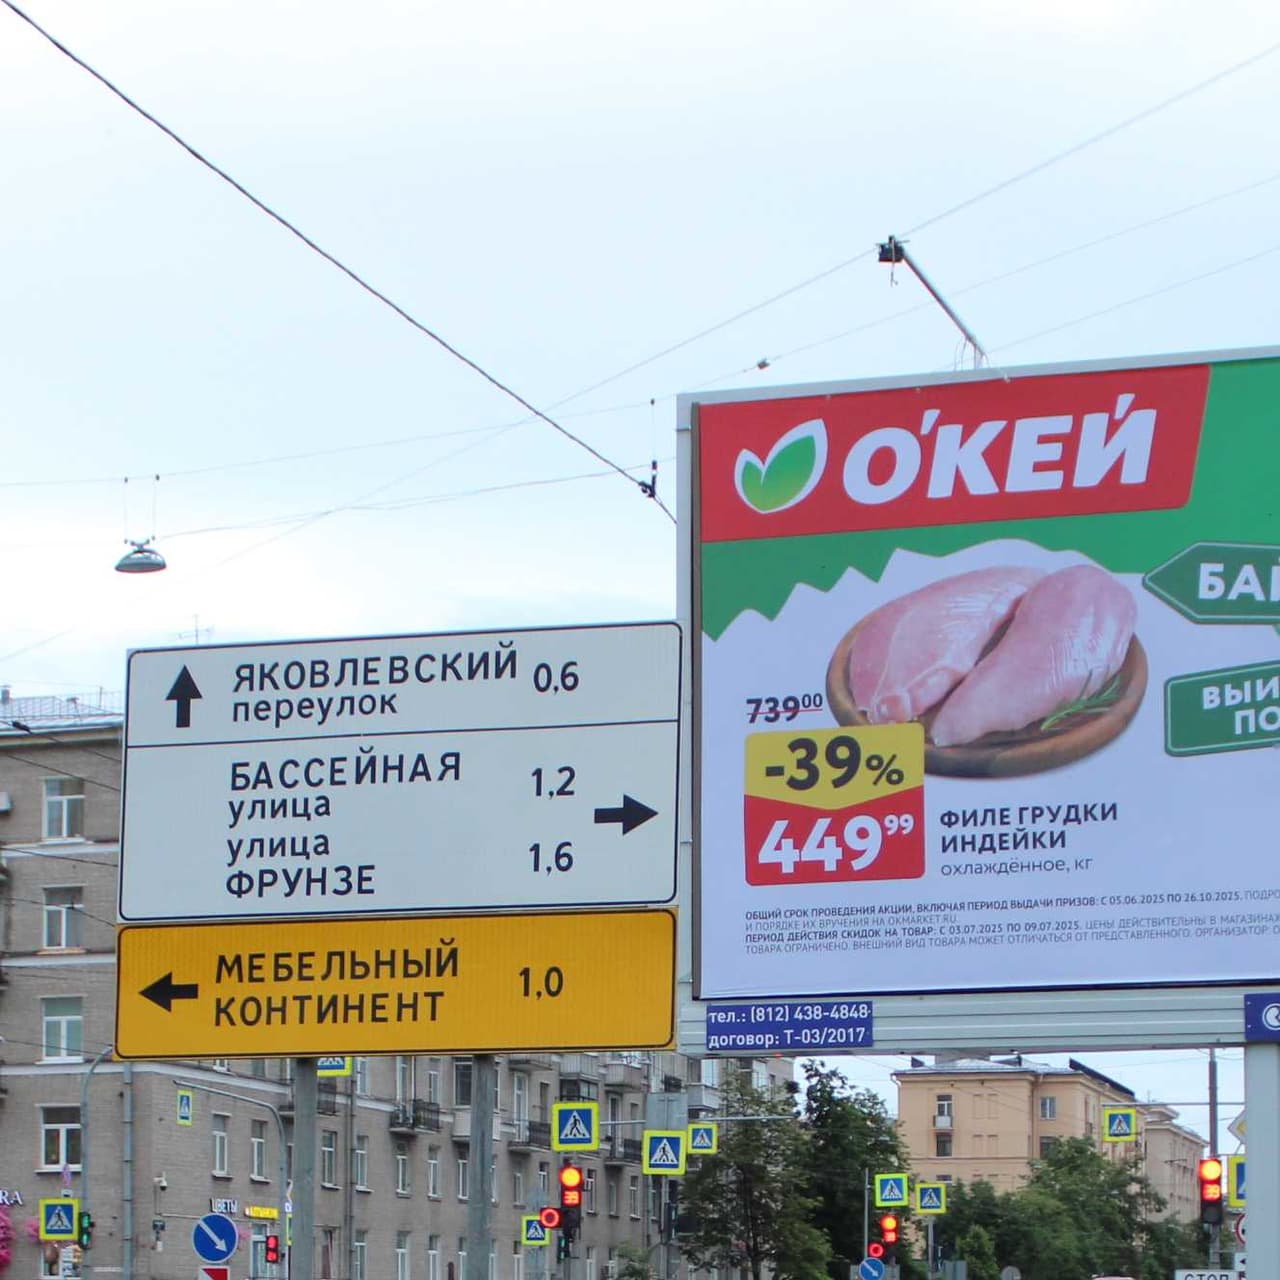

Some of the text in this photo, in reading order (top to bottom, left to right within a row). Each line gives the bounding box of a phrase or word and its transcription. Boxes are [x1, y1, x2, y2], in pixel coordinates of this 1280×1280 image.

[232, 641, 580, 695] ЯКОВЛЕВСКИЙ 0,6
[232, 692, 398, 728] переулок
[230, 745, 576, 799] БАССЕЙНАЯ 1,2
[765, 735, 904, 791] -39%
[227, 794, 331, 828] улица
[940, 802, 1119, 828] ФИЛЕ ГРУДКИ
[226, 834, 573, 876] улица 1,6
[941, 828, 1067, 854] ИНДЕЙКИ
[225, 865, 376, 899] ФРУНЗЕ
[940, 856, 1094, 878] охлаждённое, кг
[745, 907, 781, 920] ОБЩИЙ
[783, 908, 809, 919] СРОК
[811, 906, 875, 918] ПРОВЕДЕНИЯ
[917, 902, 966, 914] ВКЛЮЧАЯ
[968, 900, 1008, 912] ПЕРИОД
[1010, 899, 1052, 910] ВЫДАЧИ
[1056, 896, 1099, 907] ПРИЗОВ:
[1109, 894, 1165, 905] 05.06.2025
[1167, 893, 1182, 903] ПО
[745, 931, 784, 943] ПЕРИОД
[787, 929, 838, 942] ДЕЙСТВИЯ
[841, 928, 880, 940] СКИДОК
[885, 927, 898, 938] НА
[948, 924, 1003, 935] 03.07.2025
[1007, 922, 1021, 933] ПО
[1085, 919, 1113, 931] ЦЕНЫ
[1119, 915, 1206, 929] ДЕЙСТВИТЕЛЬНЫ
[1220, 912, 1280, 924] МАГАЗИНАХ
[755, 920, 801, 931] ПОРЯДКЕ
[819, 917, 870, 929] ВРУЧЕНИЯ
[872, 916, 885, 926] НА
[745, 943, 782, 954] ТОВАРА
[853, 937, 902, 950] ВНЕШНИЙ
[905, 938, 925, 949] ВИД
[929, 936, 966, 947] ТОВАРА
[969, 934, 1004, 946] МОЖЕТ
[1008, 932, 1072, 945] ОТЛИЧАТЬСЯ
[1075, 931, 1087, 942] ОТ
[215, 938, 564, 1000] МЕБЕЛЬНЫЙ 1,0
[214, 991, 445, 1027] КОНТИНЕНТ
[709, 1003, 869, 1024] тел.: (812) 438-4848
[709, 1027, 866, 1048] договор: Т-03/2017
